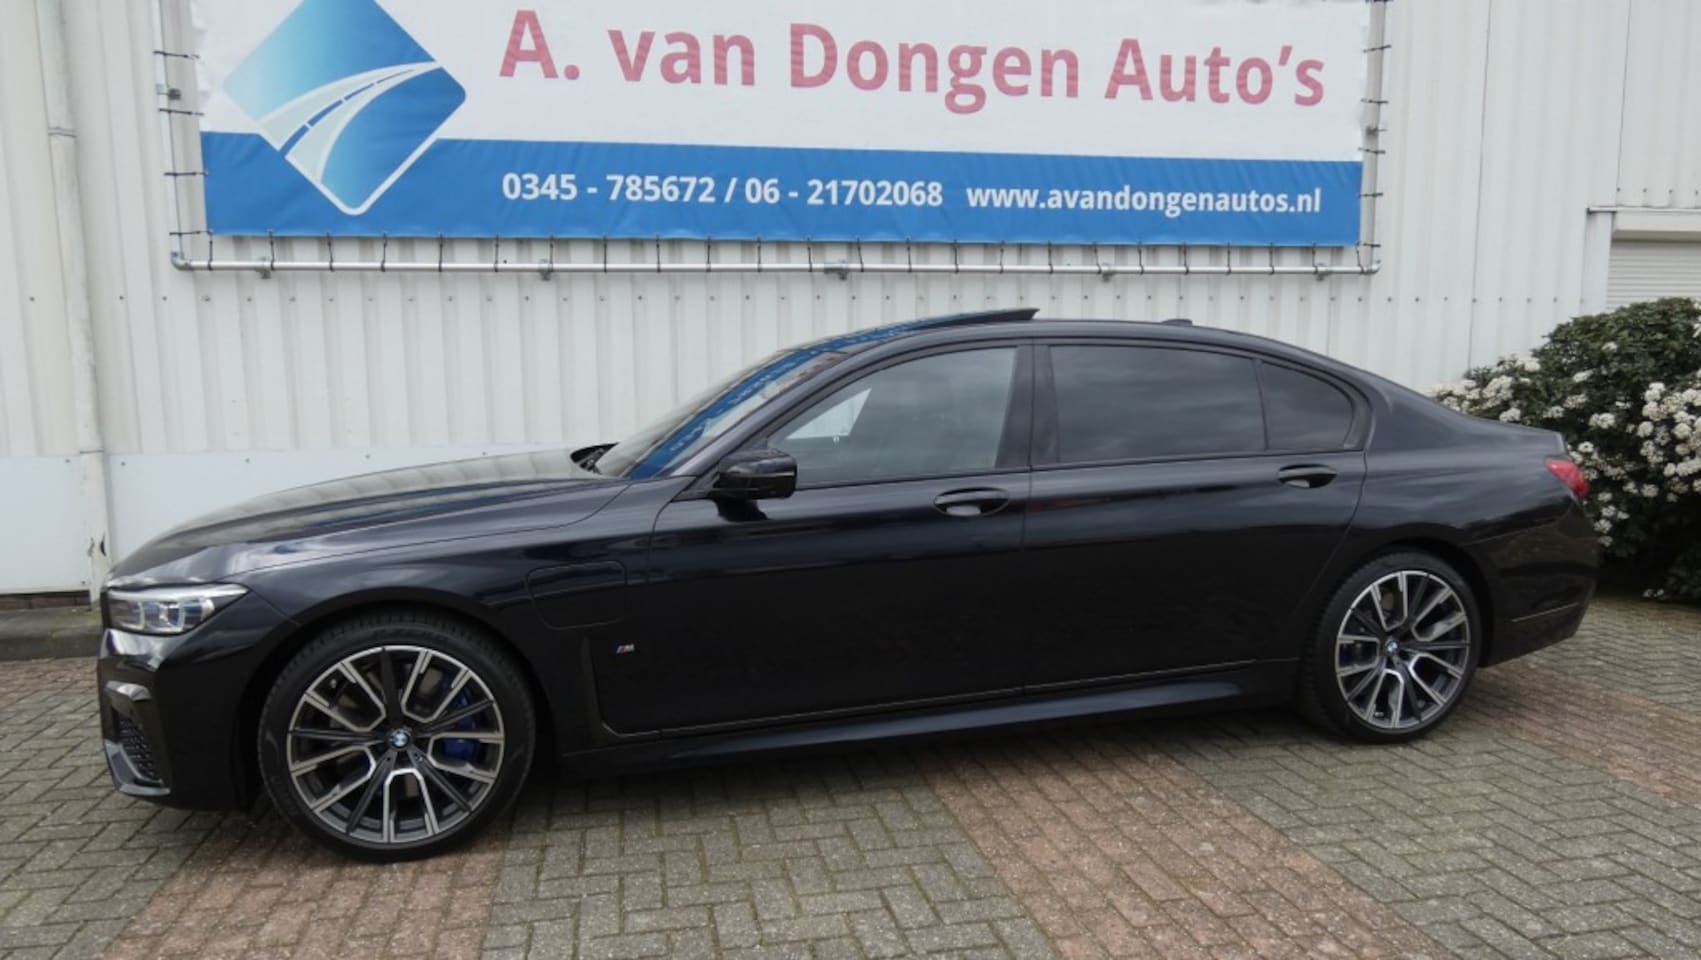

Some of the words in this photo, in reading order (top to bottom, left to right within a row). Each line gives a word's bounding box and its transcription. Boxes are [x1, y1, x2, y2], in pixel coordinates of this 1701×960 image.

[500, 8, 580, 80] A.
[607, 29, 755, 86] van
[790, 23, 1080, 114] Dongen
[1105, 38, 1325, 106] Auto’s
[502, 172, 578, 201] 0345
[587, 187, 598, 195] -
[606, 174, 716, 203] 785672
[724, 177, 737, 204] /
[744, 177, 781, 205] 06
[788, 190, 799, 198] -
[807, 178, 943, 207] 21702068
[966, 184, 1321, 218] www.avandongenautos.nl
